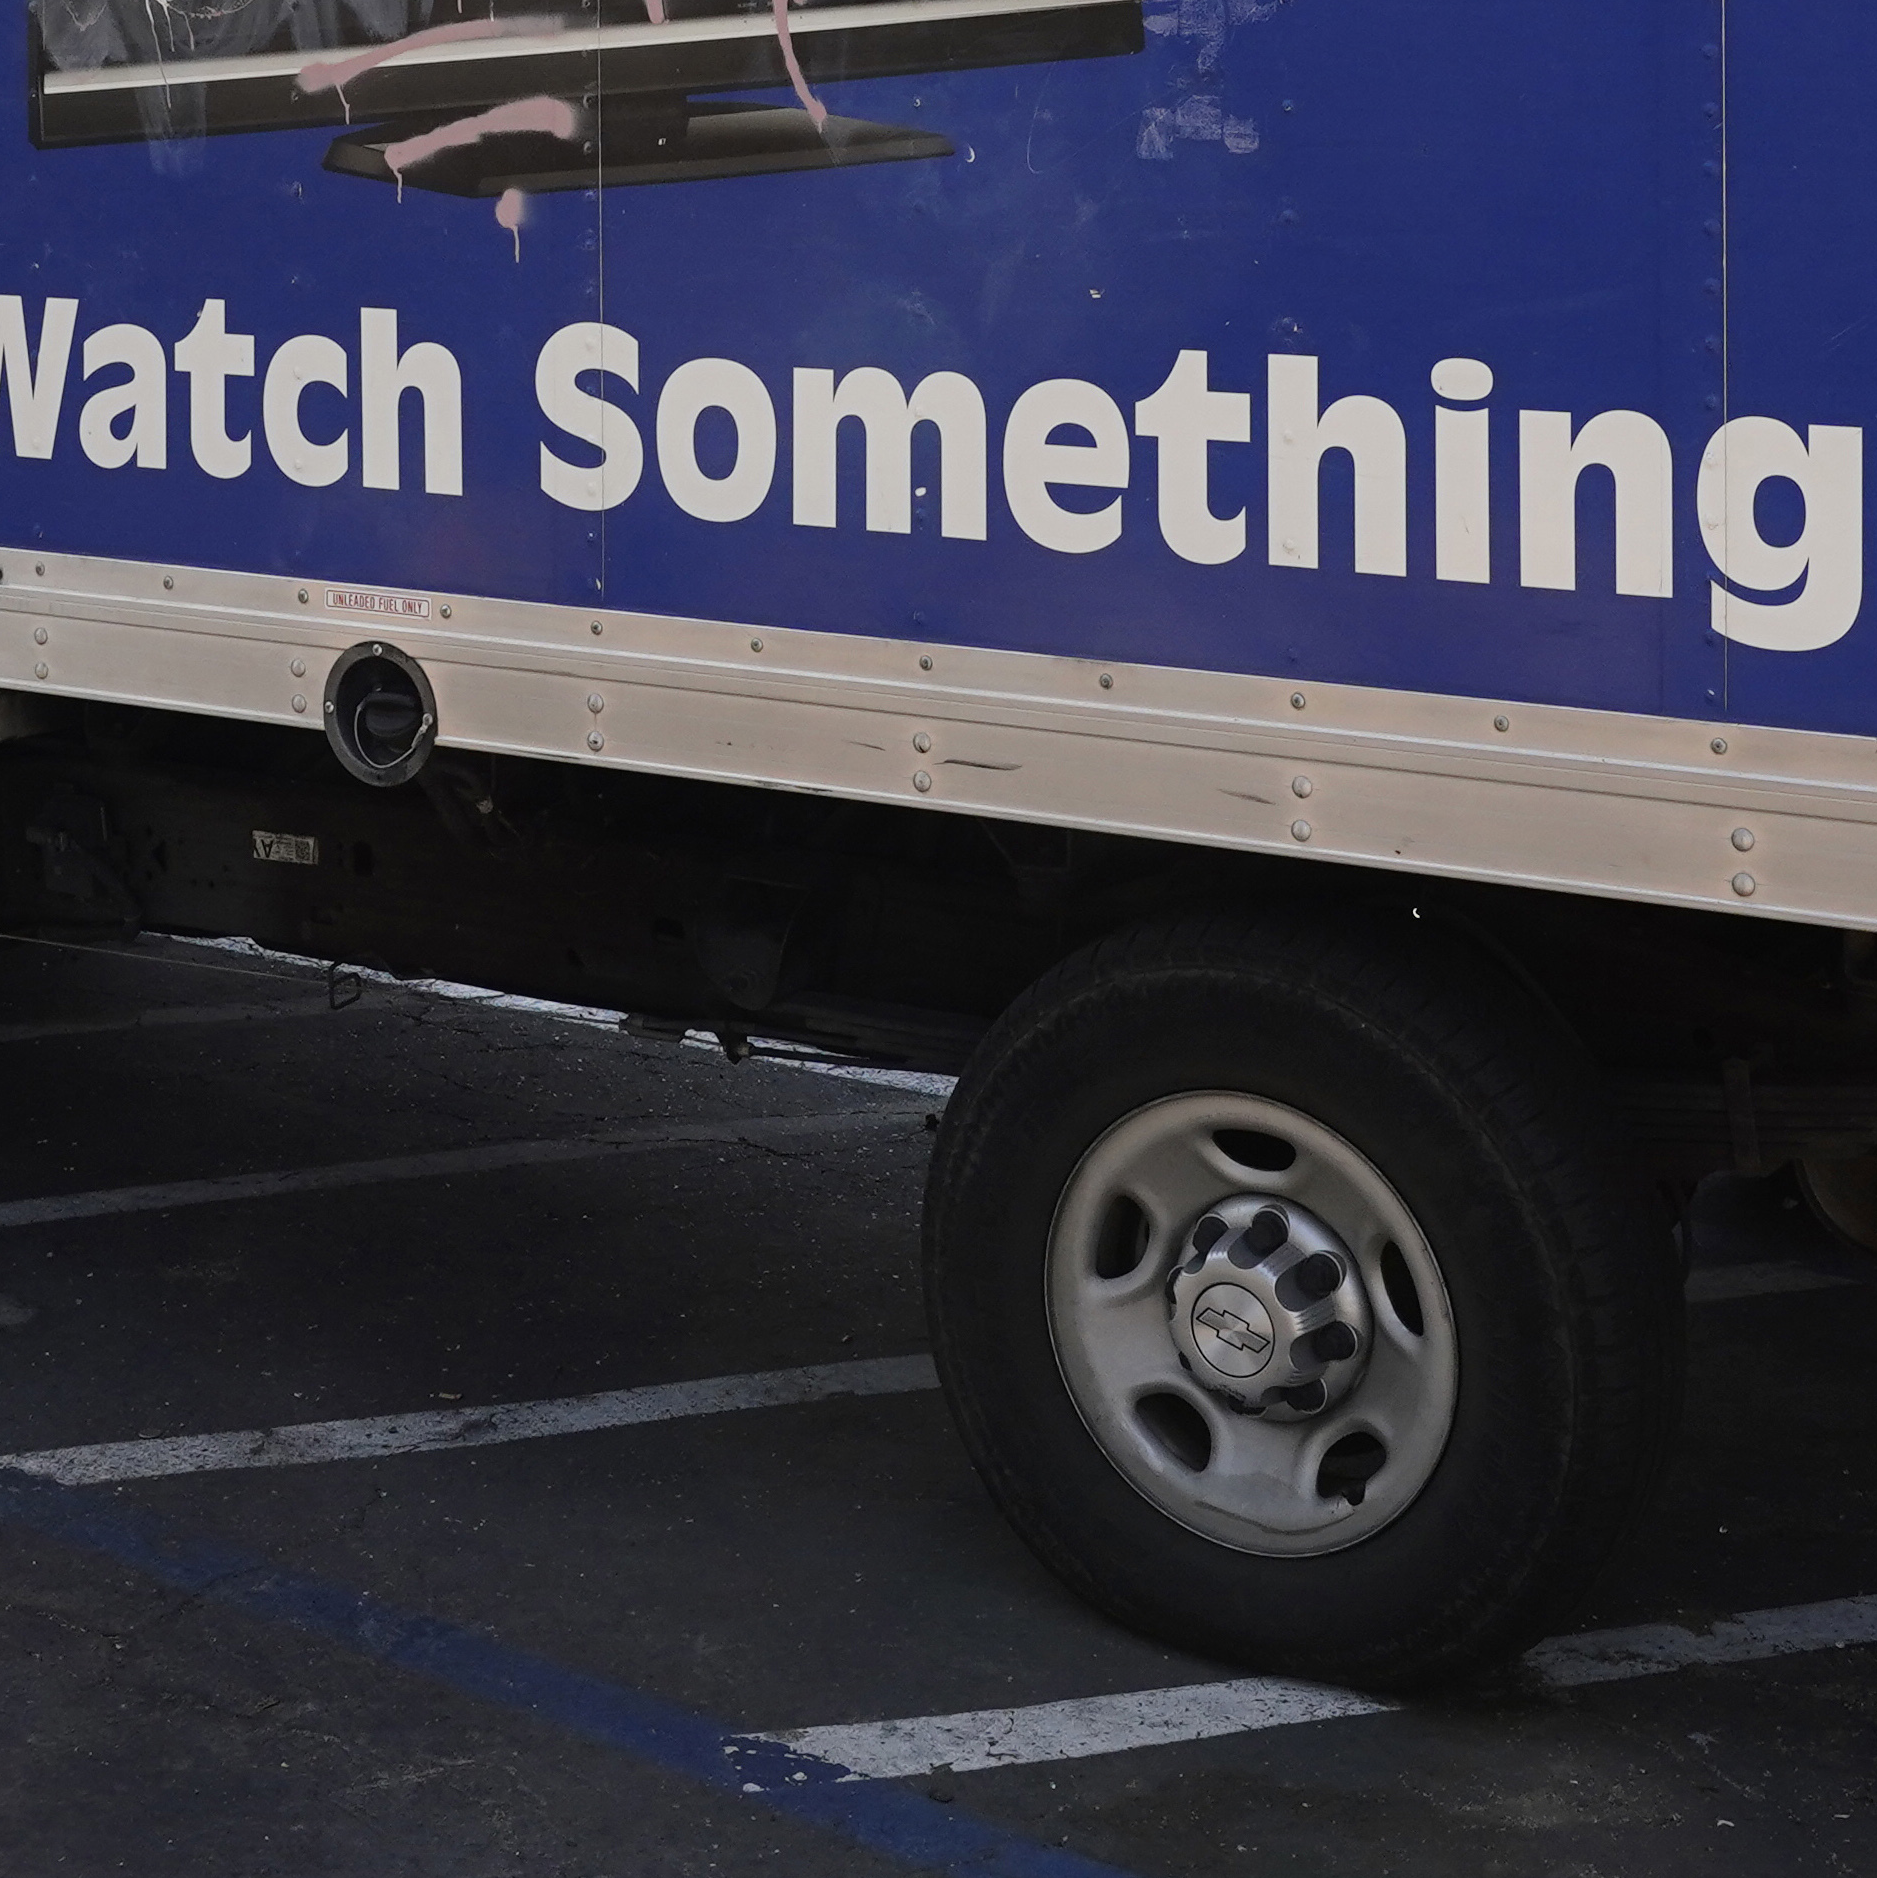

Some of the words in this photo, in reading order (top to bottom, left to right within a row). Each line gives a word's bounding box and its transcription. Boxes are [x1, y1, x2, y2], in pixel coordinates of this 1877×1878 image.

[535, 321, 1863, 651] Something
[332, 592, 375, 610] UNLEADED
[378, 597, 399, 613] FUEL
[402, 600, 423, 614] ONLY
